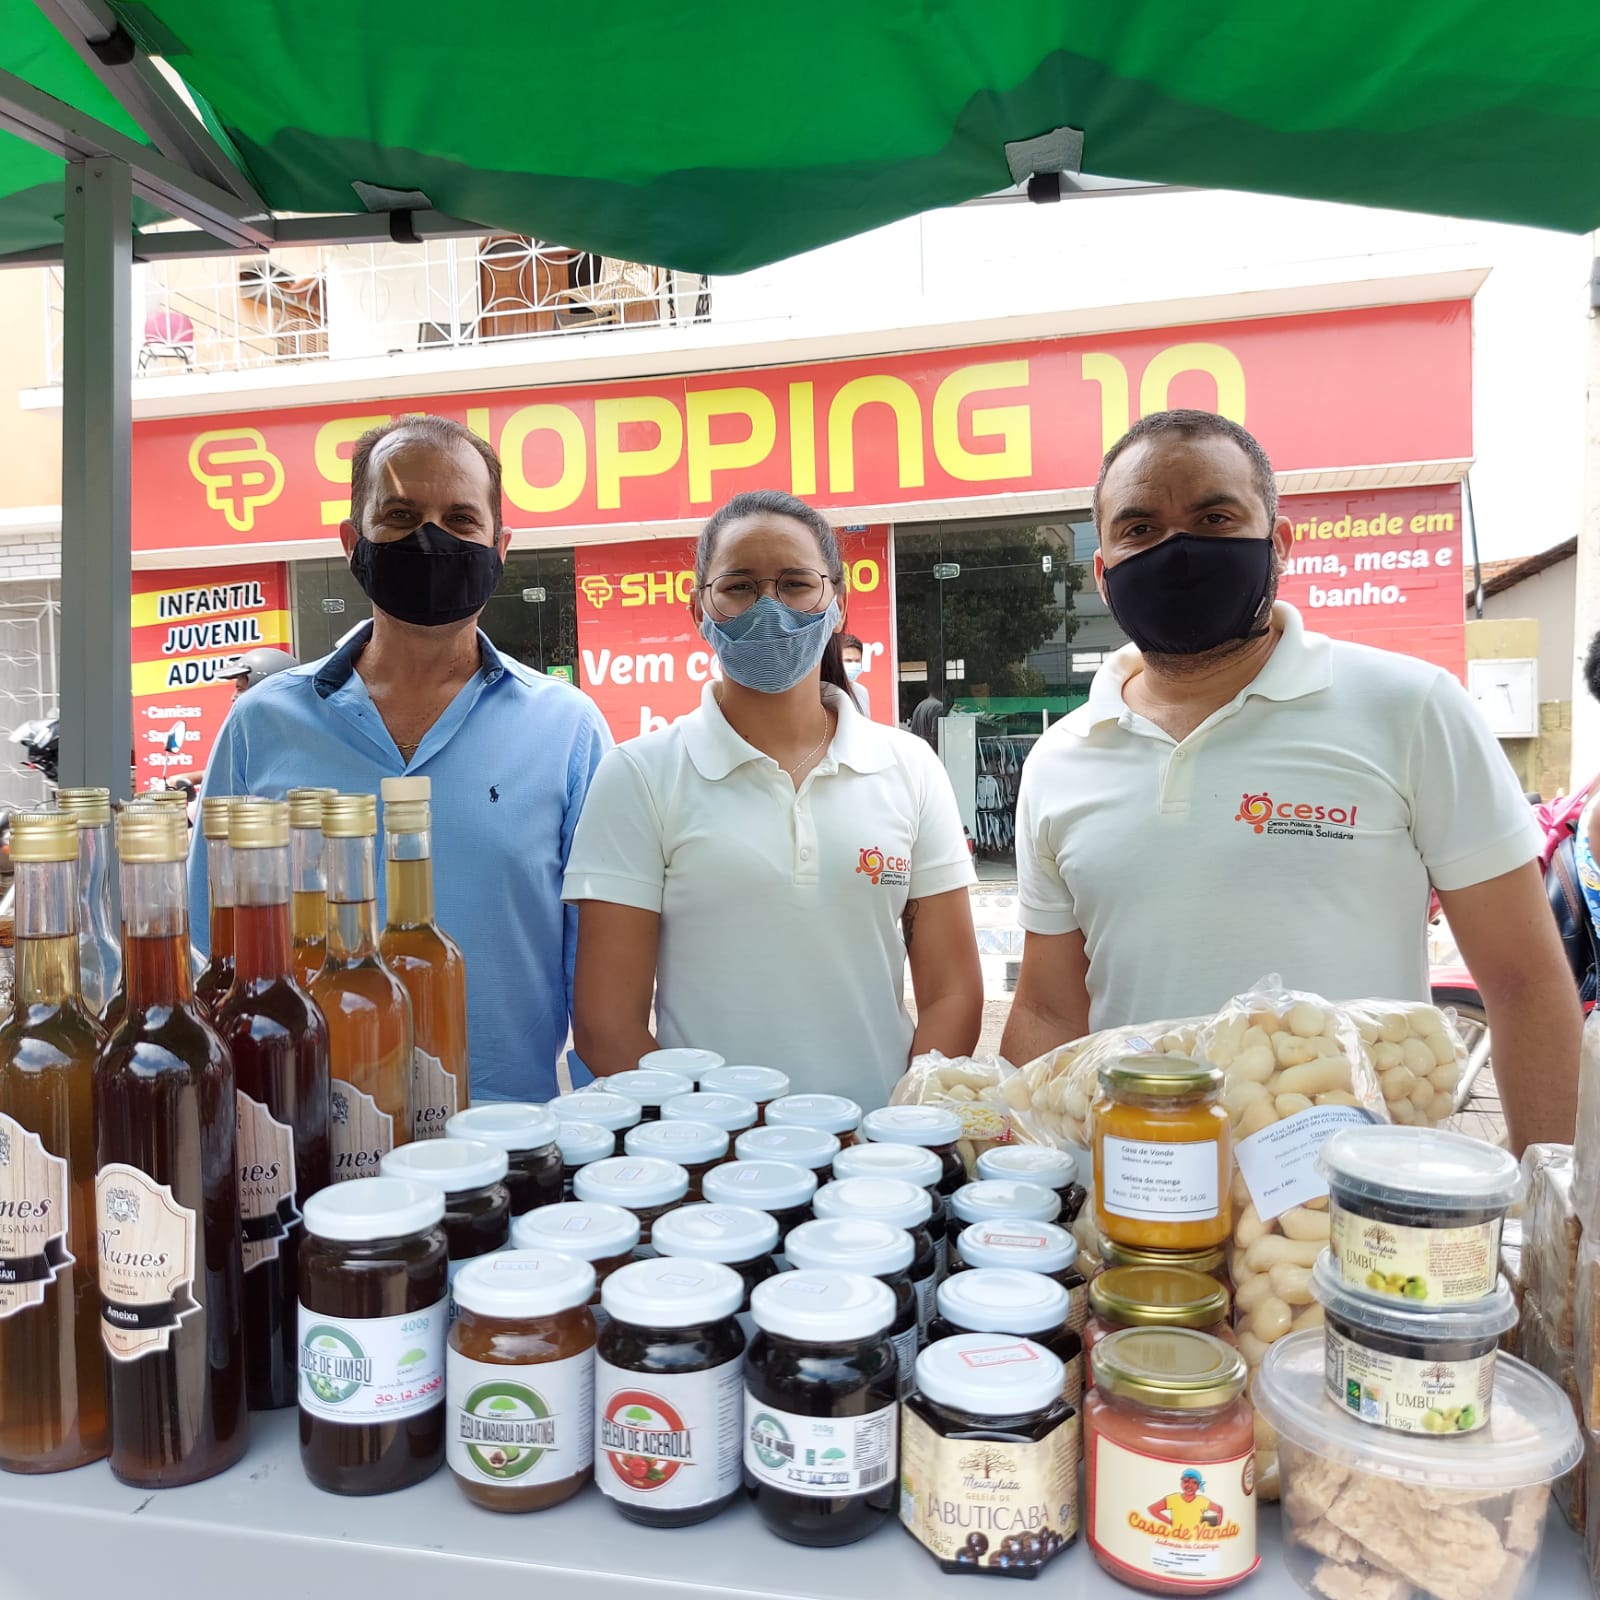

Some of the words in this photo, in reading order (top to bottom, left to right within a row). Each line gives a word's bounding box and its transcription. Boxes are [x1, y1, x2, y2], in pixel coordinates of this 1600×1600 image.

[1295, 512, 1405, 541] riedade
[1410, 512, 1454, 534] em
[1282, 553, 1347, 577] ama,
[1354, 548, 1430, 572] mesa
[1435, 547, 1453, 567] e
[159, 582, 264, 618] INFANTIL
[1309, 582, 1407, 608] banho.
[165, 619, 261, 652] JUVENIL
[168, 656, 242, 687] ADU
[582, 648, 675, 686] Vem
[147, 704, 202, 719] Camisas
[1276, 802, 1358, 826] cesol
[1315, 828, 1355, 841] Solidária
[886, 855, 912, 872] ces
[335, 1149, 383, 1168] nes
[241, 1186, 276, 1197] SANAL
[1120, 1173, 1143, 1183] Geleia
[1144, 1176, 1154, 1184] de
[1155, 1178, 1181, 1186] manga
[0, 1198, 52, 1219] nes
[99, 1229, 169, 1268] Nunes
[1346, 1249, 1377, 1273] UMBU
[106, 1304, 139, 1323] Ameixa
[400, 1317, 430, 1333] 400g
[319, 1355, 333, 1375] DE
[334, 1357, 372, 1384] UMBU
[1395, 1391, 1436, 1409] UMBU
[601, 1417, 626, 1449] GELEIA
[627, 1429, 640, 1452] DE
[642, 1430, 692, 1459] ACEROLA
[927, 1490, 1050, 1532] JABUTICABA
[1128, 1511, 1171, 1538] Casa
[1171, 1523, 1191, 1541] de
[1194, 1520, 1240, 1540] Vanda
